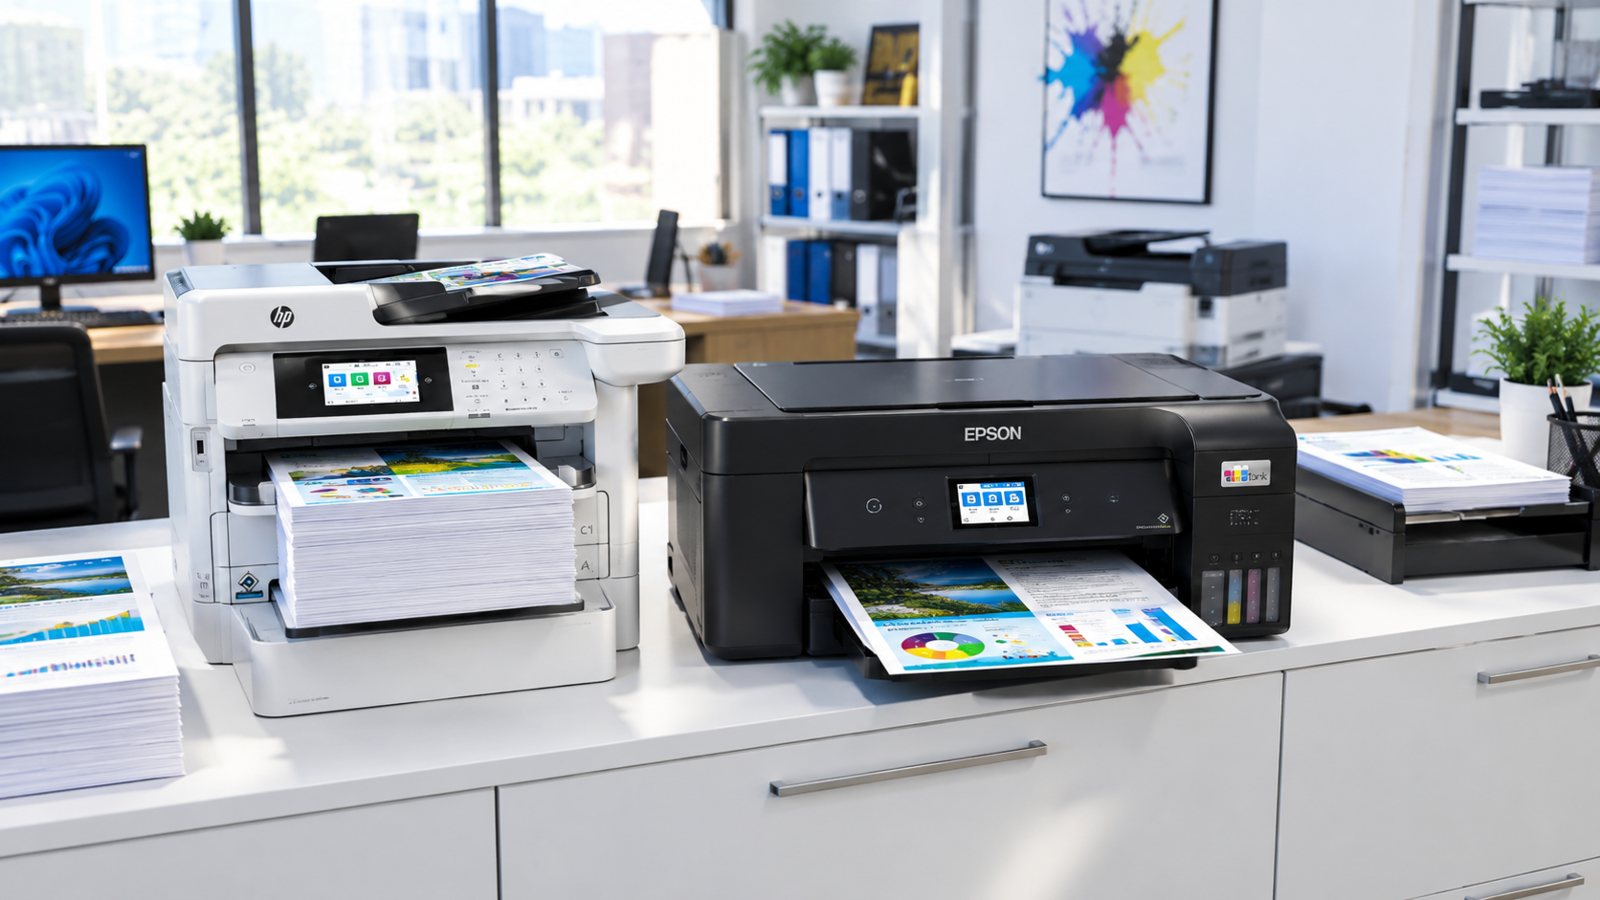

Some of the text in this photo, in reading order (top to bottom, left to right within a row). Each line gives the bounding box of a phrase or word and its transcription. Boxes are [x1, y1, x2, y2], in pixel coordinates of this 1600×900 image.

[272, 305, 293, 328] hp
[964, 426, 1022, 441] EPSON
[580, 560, 590, 570] A
